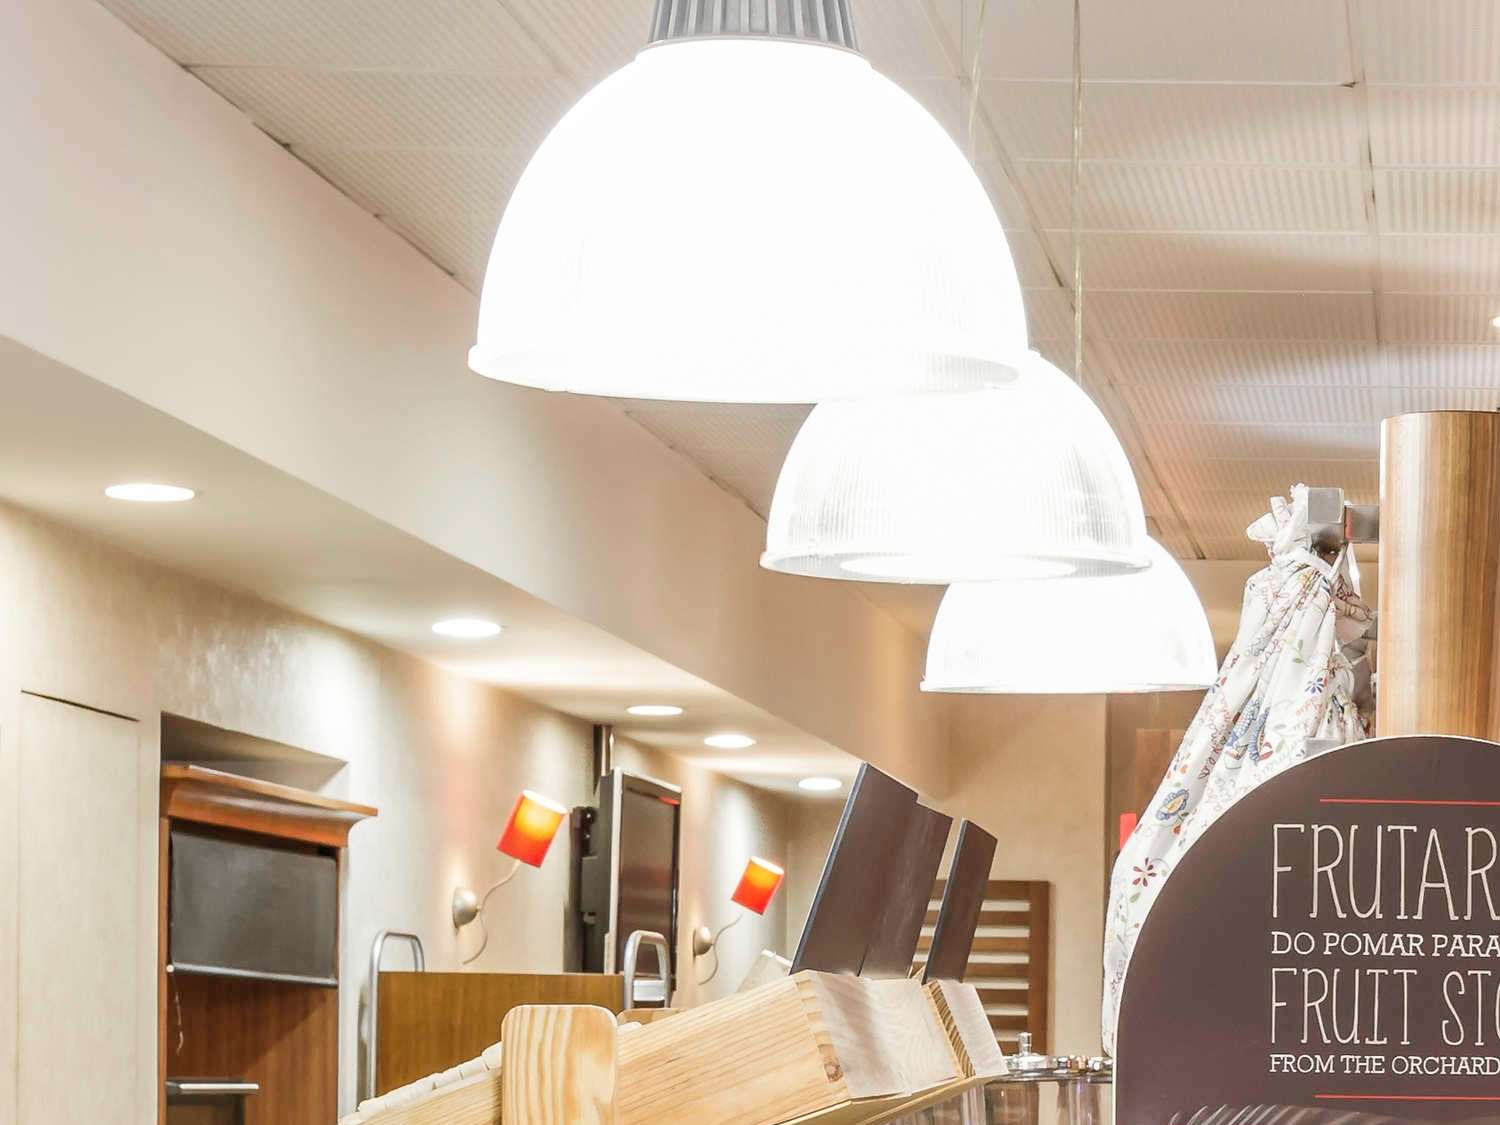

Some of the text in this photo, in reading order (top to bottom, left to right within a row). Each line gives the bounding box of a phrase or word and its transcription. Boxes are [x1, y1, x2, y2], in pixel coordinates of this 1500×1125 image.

[1272, 932, 1314, 954] DO
[1323, 933, 1425, 956] POMAR
[1272, 968, 1417, 1044] FRUIT
[1270, 1054, 1334, 1073] FROM
[1341, 1055, 1385, 1073] THE
[1392, 1056, 1500, 1075] ORCHARD
